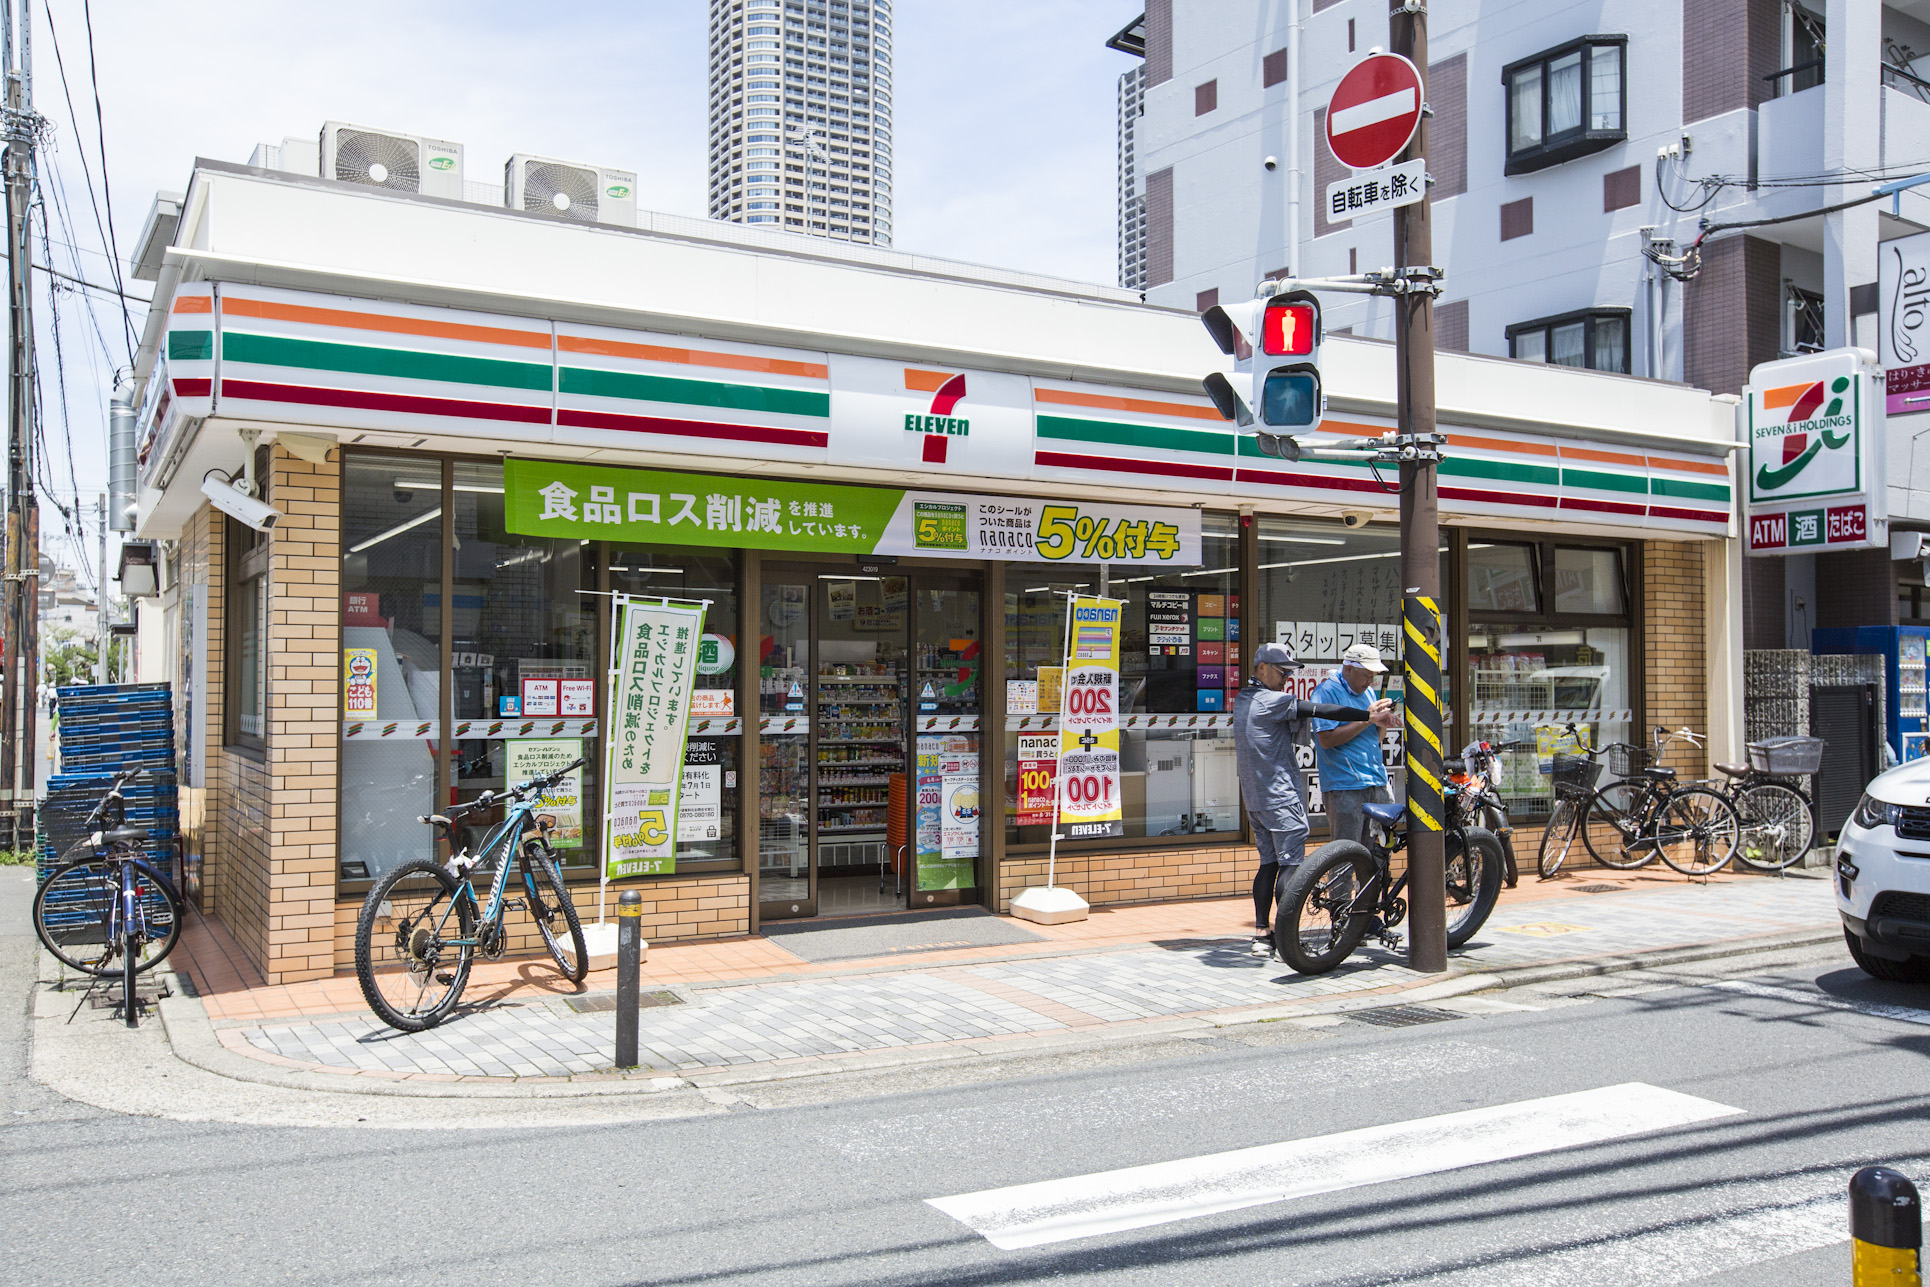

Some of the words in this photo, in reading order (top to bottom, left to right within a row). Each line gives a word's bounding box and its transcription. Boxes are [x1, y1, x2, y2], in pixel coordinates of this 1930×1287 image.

[428, 144, 458, 154] TOSHIBA
[605, 174, 632, 183] TOSHIBA
[1332, 173, 1418, 214] 自転車を除く
[1799, 415, 1852, 432] HOLDINGS
[538, 480, 783, 535] 食品ロス削減
[788, 500, 834, 519] を推進
[979, 504, 1032, 517] このシールが
[979, 517, 1032, 529] ついた商品は
[1795, 515, 1818, 542] 酒
[1829, 512, 1865, 537] たばこ
[789, 520, 868, 540] しています。
[918, 519, 964, 544] 5%付与
[1034, 504, 1181, 560] 5%付与
[1753, 518, 1784, 544] ATM
[980, 530, 1033, 548] nanaco
[349, 596, 367, 605] 銀行
[1150, 601, 1189, 610] マルチコピー機
[348, 605, 368, 613] ATM
[1280, 630, 1396, 653] スタッフ募集
[698, 664, 719, 672] liquor
[349, 685, 372, 698] こども
[692, 694, 715, 702] の商品
[348, 698, 373, 710] 110番
[1020, 738, 1058, 748] nanac
[1382, 731, 1402, 767] 予
[517, 753, 573, 761] 食品ロス削減のため
[1036, 750, 1055, 758] 買うと
[919, 792, 938, 804] 200
[1021, 790, 1028, 808] 1
